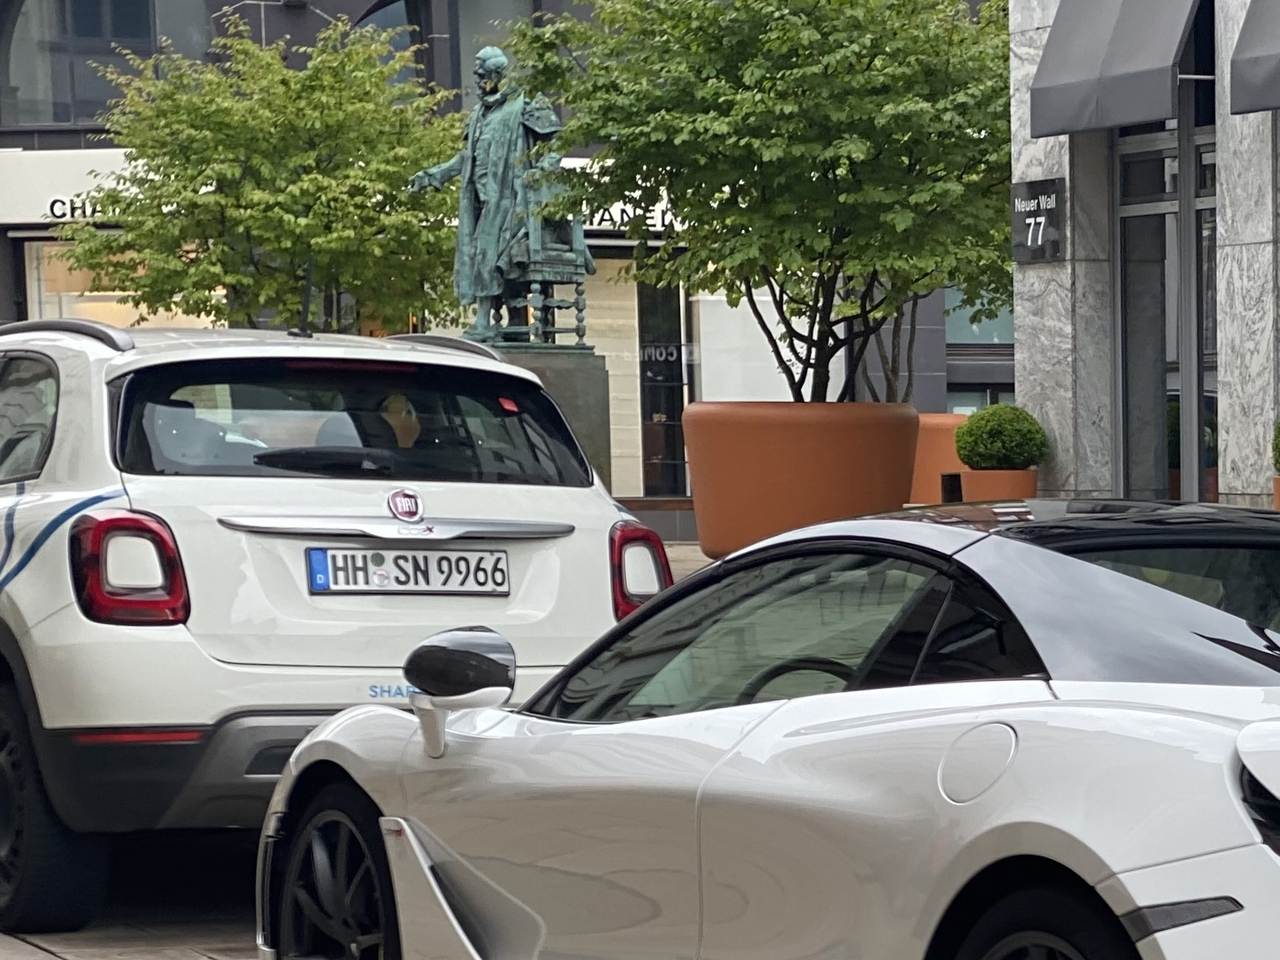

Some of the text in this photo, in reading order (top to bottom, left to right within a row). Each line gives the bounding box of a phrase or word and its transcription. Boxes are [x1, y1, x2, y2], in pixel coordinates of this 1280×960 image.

[1015, 194, 1056, 212] Neuer Wall
[1026, 217, 1045, 246] 77
[395, 497, 417, 512] FIAT
[317, 554, 506, 587] D HH SN 9966
